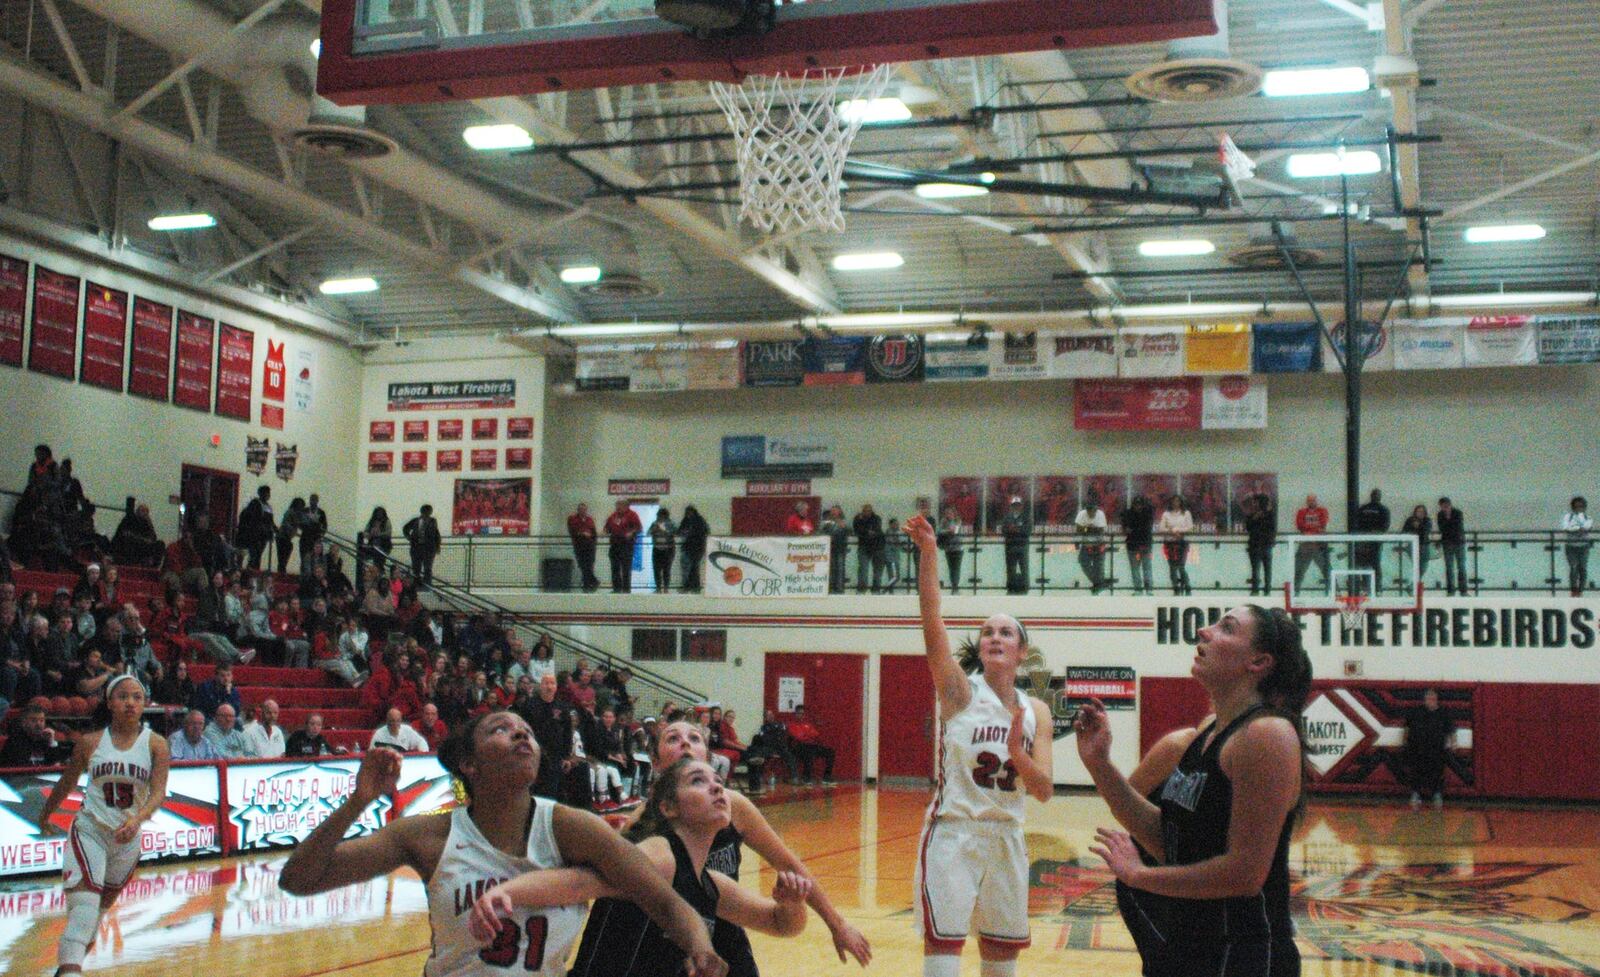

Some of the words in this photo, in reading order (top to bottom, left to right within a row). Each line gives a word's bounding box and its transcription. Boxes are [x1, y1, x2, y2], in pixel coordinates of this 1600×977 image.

[750, 343, 800, 363] PARK
[270, 372, 280, 388] 10
[391, 385, 429, 396] Lakota
[432, 384, 459, 395] West
[462, 382, 512, 395] Firebirds
[610, 482, 668, 494] CONCESSIONS
[787, 543, 827, 552] Promoting
[785, 575, 800, 583] High
[804, 574, 828, 582] School
[741, 578, 782, 597] OGBR
[787, 585, 824, 594] Basketball
[1391, 607, 1596, 649] FIREBIRDS
[1069, 670, 1099, 680] WATCH
[1100, 670, 1118, 680] LIVE
[1120, 670, 1133, 680] ON
[971, 726, 1009, 745] LAKOT
[92, 762, 125, 778] LAKOTA
[102, 781, 134, 810] 15
[242, 778, 320, 803] LAKOTA
[255, 812, 298, 834] HIGH
[478, 915, 549, 972] 31
